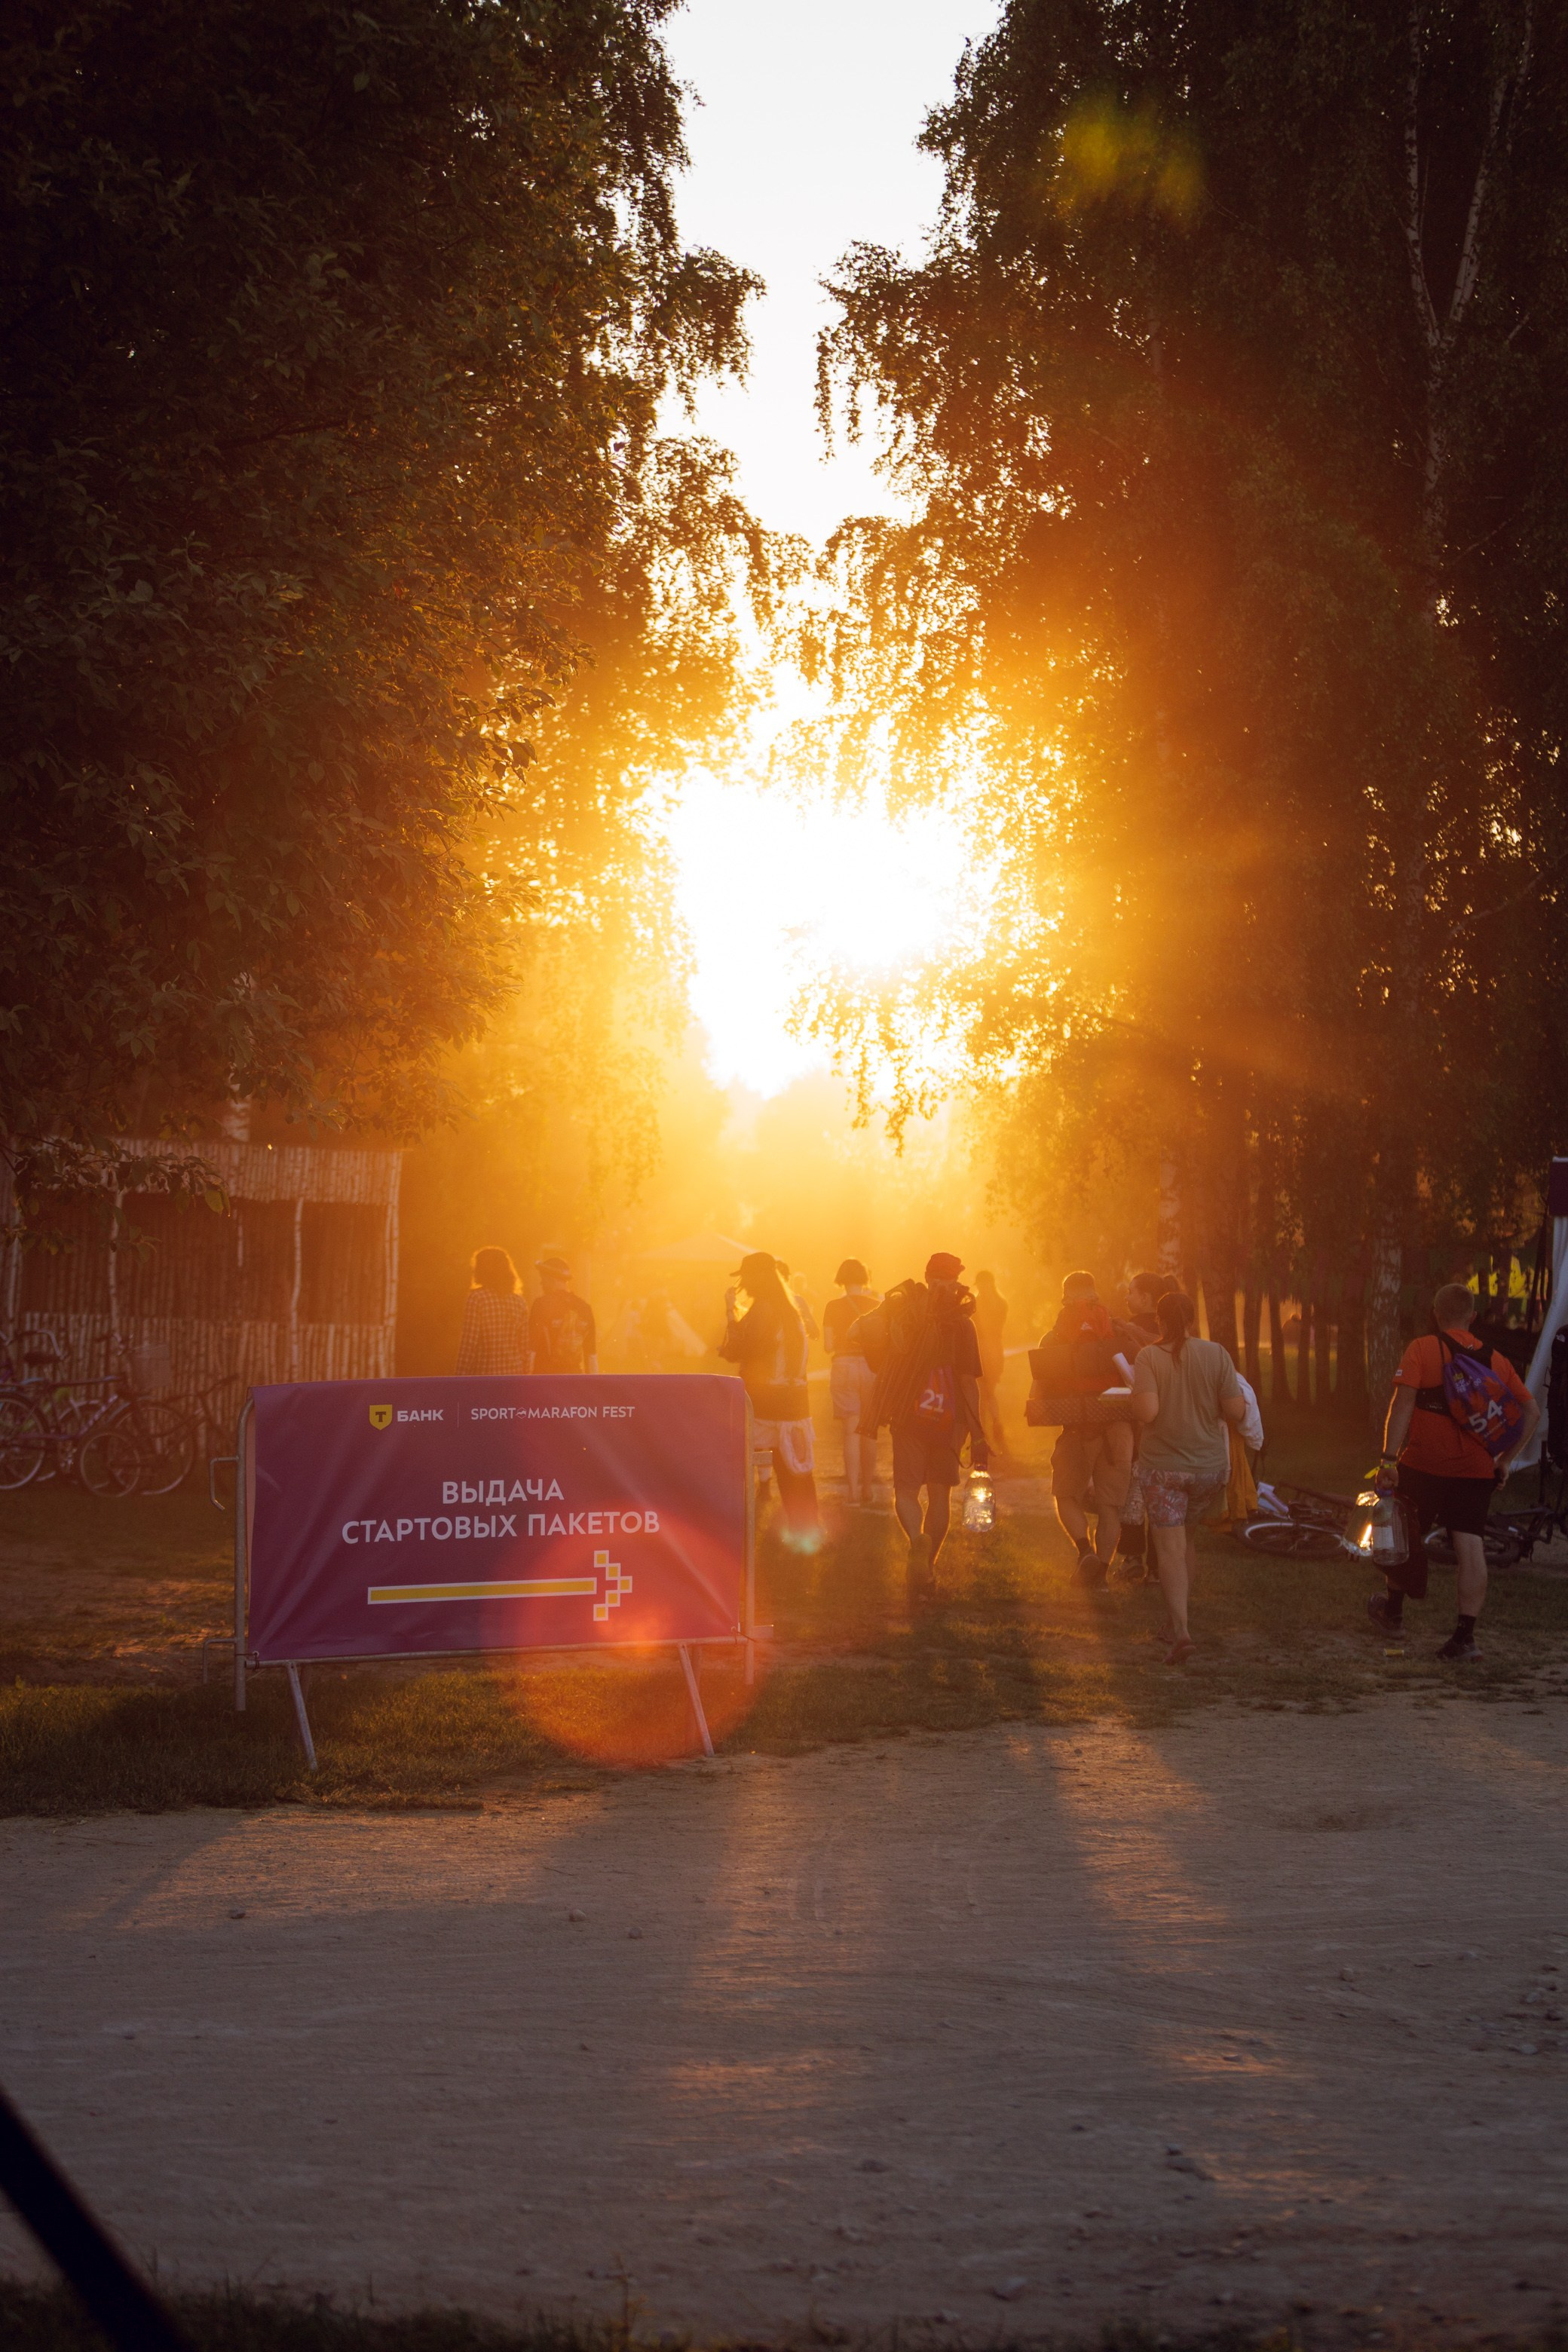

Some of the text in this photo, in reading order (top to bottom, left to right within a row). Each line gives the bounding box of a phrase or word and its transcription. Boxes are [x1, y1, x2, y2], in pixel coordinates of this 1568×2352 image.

[603, 1406, 635, 1418] FEST
[920, 1389, 944, 1413] 21
[397, 1410, 443, 1422] БАНК
[1469, 1401, 1502, 1432] 54
[443, 1478, 565, 1506] ВЫДАЧА
[341, 1511, 660, 1544] СТАРТОВЫХ ПАКЕТОВ
